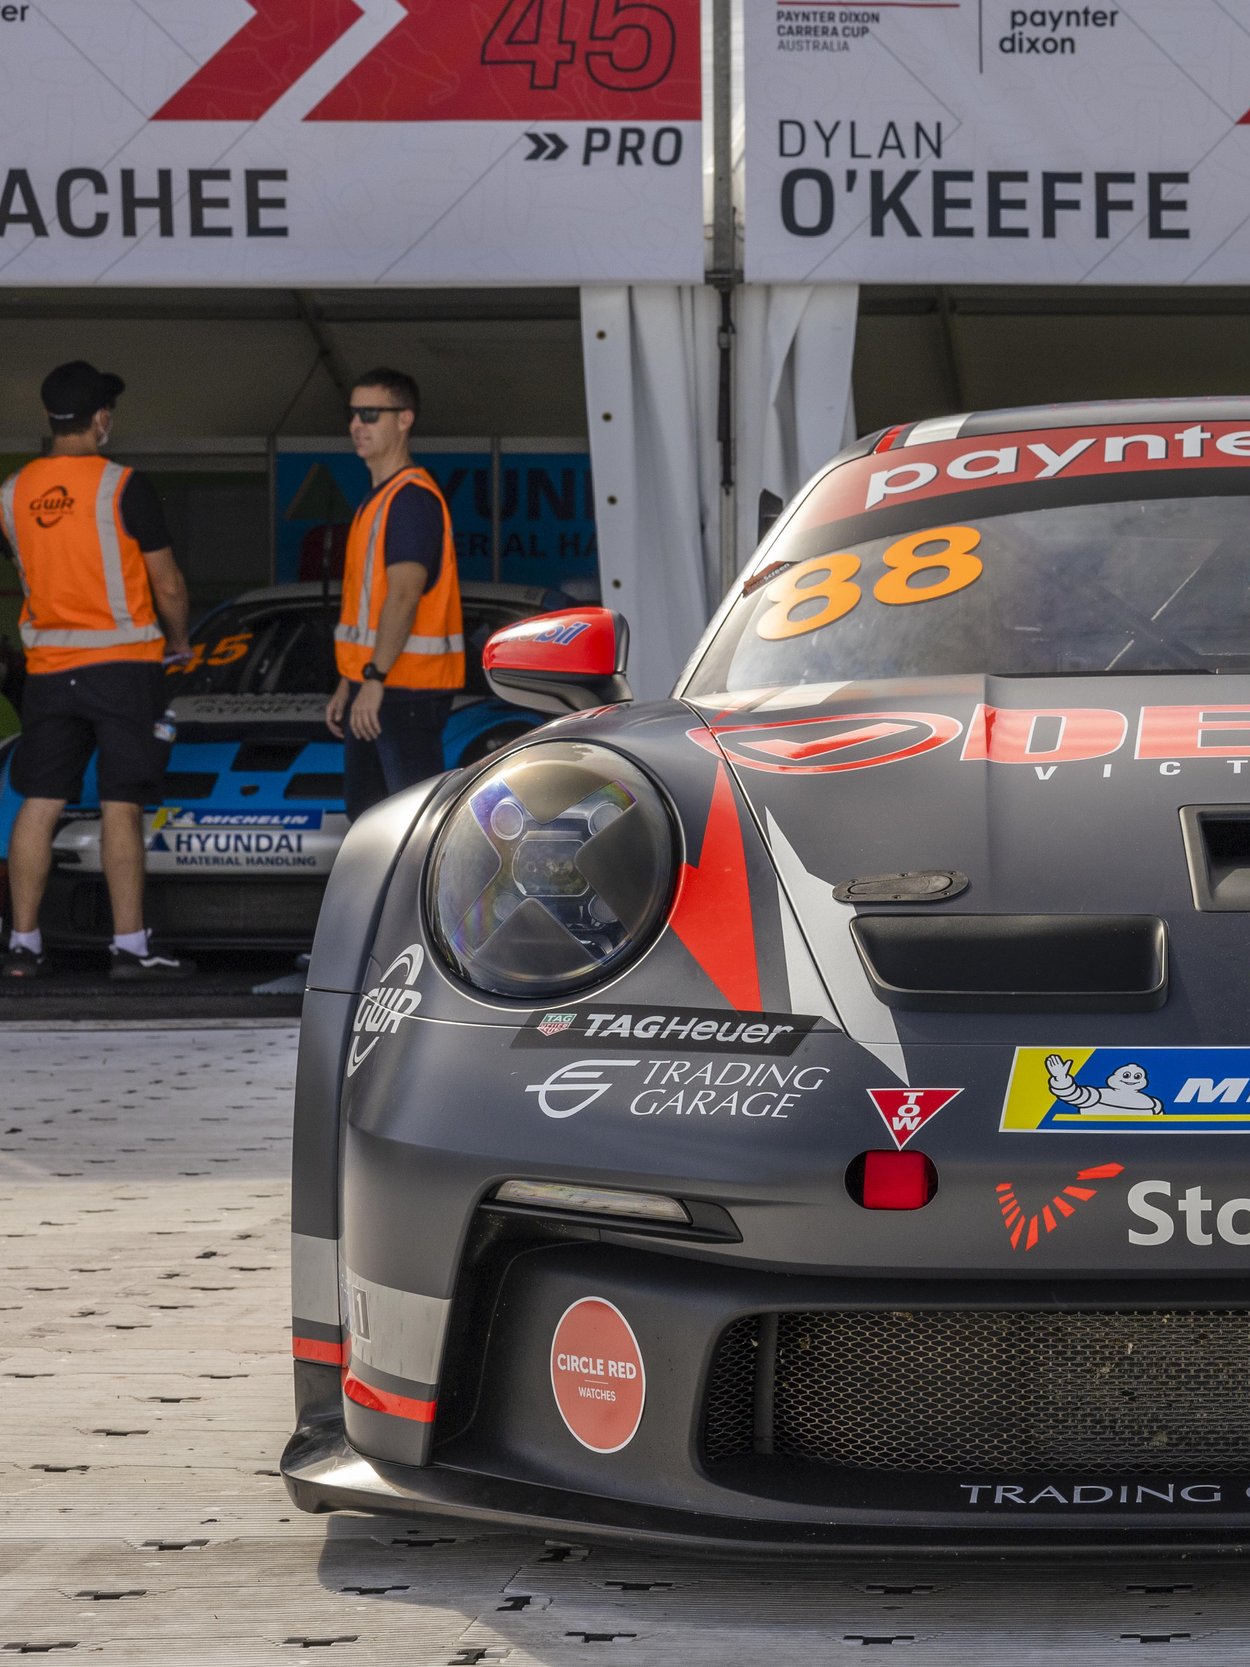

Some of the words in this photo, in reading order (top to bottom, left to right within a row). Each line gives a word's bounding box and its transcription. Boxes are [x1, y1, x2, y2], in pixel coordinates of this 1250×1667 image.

[776, 11, 836, 25] PAYNTER
[839, 11, 880, 25] DIXON
[776, 25, 840, 38] CARRERA
[842, 26, 870, 38] CUP
[1009, 5, 1119, 34] paynter
[481, 0, 677, 91] 45
[777, 39, 850, 52] AUSTRALIA
[999, 31, 1076, 54] dixon
[581, 127, 684, 166] PRO
[778, 120, 943, 160] DYLAN
[0, 167, 289, 238] ACHEE
[780, 168, 1190, 239] O'KEEFFE
[756, 525, 983, 641] 88
[199, 814, 311, 825] MICHELIN
[175, 834, 302, 853] HYUNDAI
[175, 856, 242, 866] MATERIAL
[245, 855, 316, 866] HANDLING
[643, 1059, 830, 1091] TRADING
[629, 1089, 802, 1119] GARAGE
[891, 1091, 923, 1131] TOW
[556, 1353, 605, 1376] CIRCLE
[607, 1358, 637, 1380] RED
[577, 1385, 617, 1402] WATCHES
[960, 1482, 1223, 1505] TRADING
